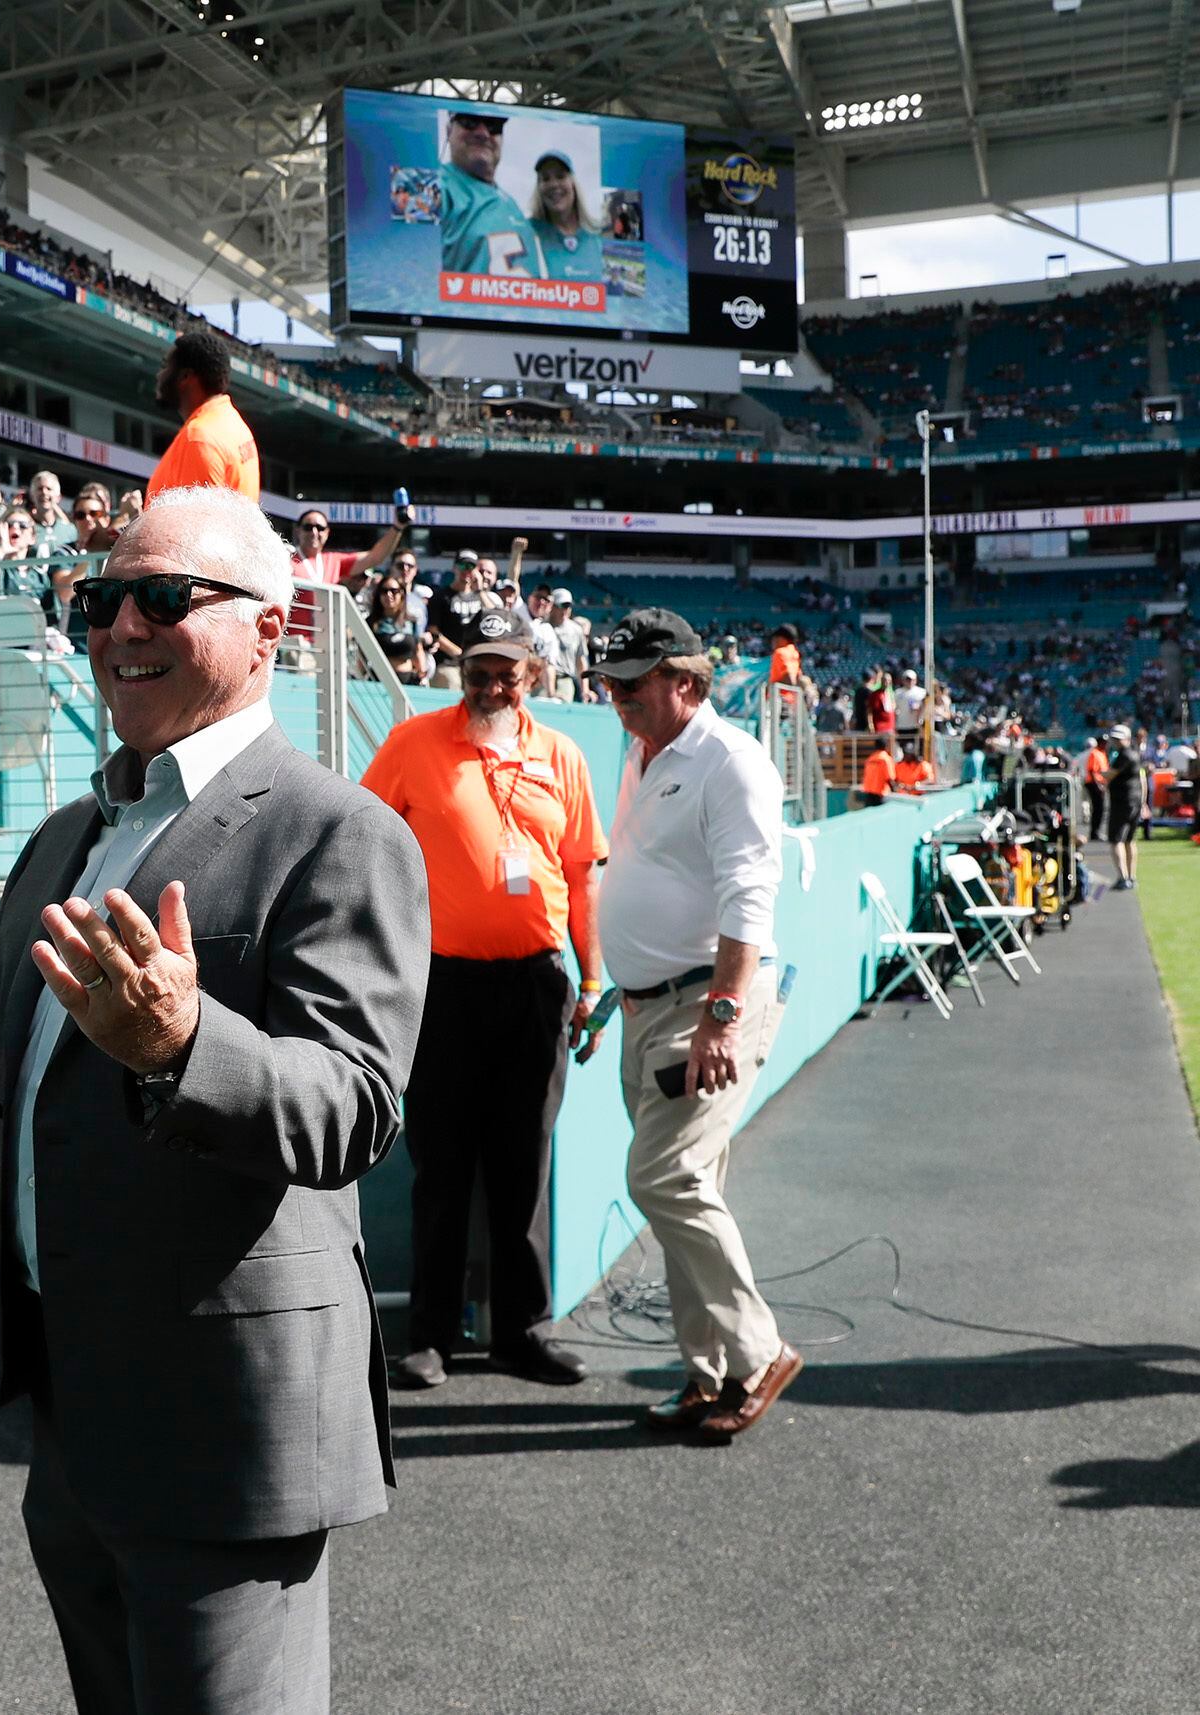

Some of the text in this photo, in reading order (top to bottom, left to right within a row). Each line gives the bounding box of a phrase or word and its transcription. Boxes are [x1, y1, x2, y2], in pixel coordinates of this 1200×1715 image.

[704, 160, 778, 190] Hard Rock
[713, 225, 771, 265] 26:13
[470, 278, 581, 307] #MSCFinsUp
[514, 347, 638, 384] verizon
